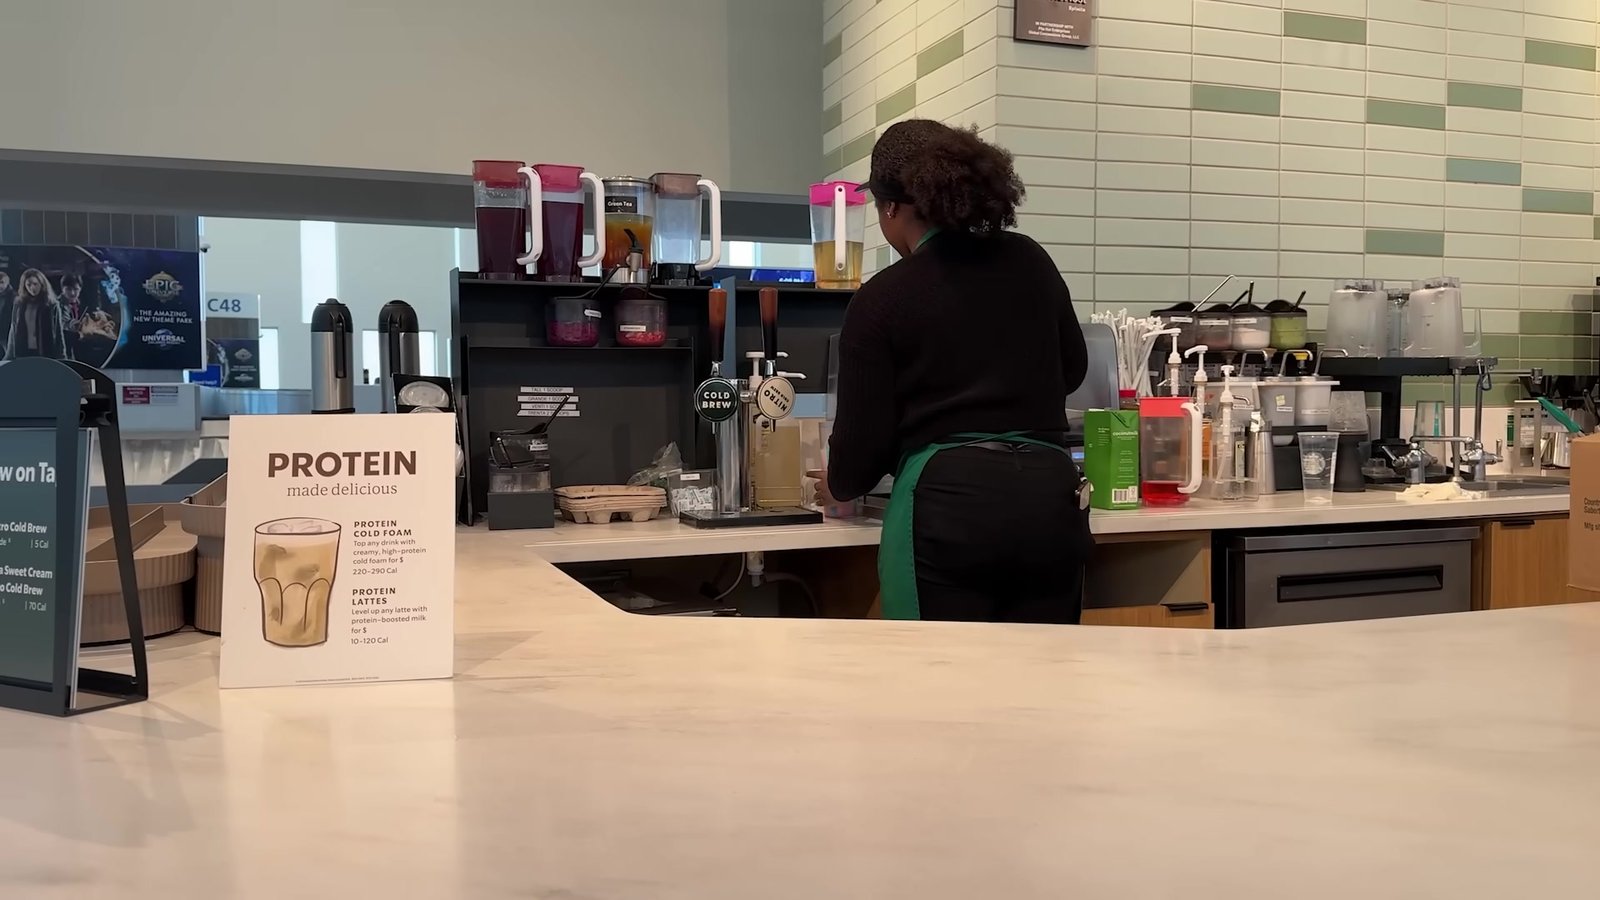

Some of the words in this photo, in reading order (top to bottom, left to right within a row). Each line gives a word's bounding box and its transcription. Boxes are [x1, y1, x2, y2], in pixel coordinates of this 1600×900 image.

[146, 280, 180, 290] EPIC
[208, 298, 241, 312] C48
[764, 389, 788, 412] NITRO
[268, 451, 416, 478] PROTEIN
[16, 466, 35, 482] on
[39, 462, 57, 487] Ta
[287, 484, 328, 497] made
[331, 482, 398, 496] delicious
[10, 522, 26, 532] Cold
[27, 522, 47, 534] Brew
[40, 540, 48, 548] Cal
[4, 565, 27, 577] Sweet
[28, 567, 53, 579] Cream
[6, 582, 22, 594] Cold
[24, 584, 43, 596] Brew
[29, 602, 36, 610] 70
[37, 602, 47, 611] Cal
[352, 616, 410, 624] protein-boosted
